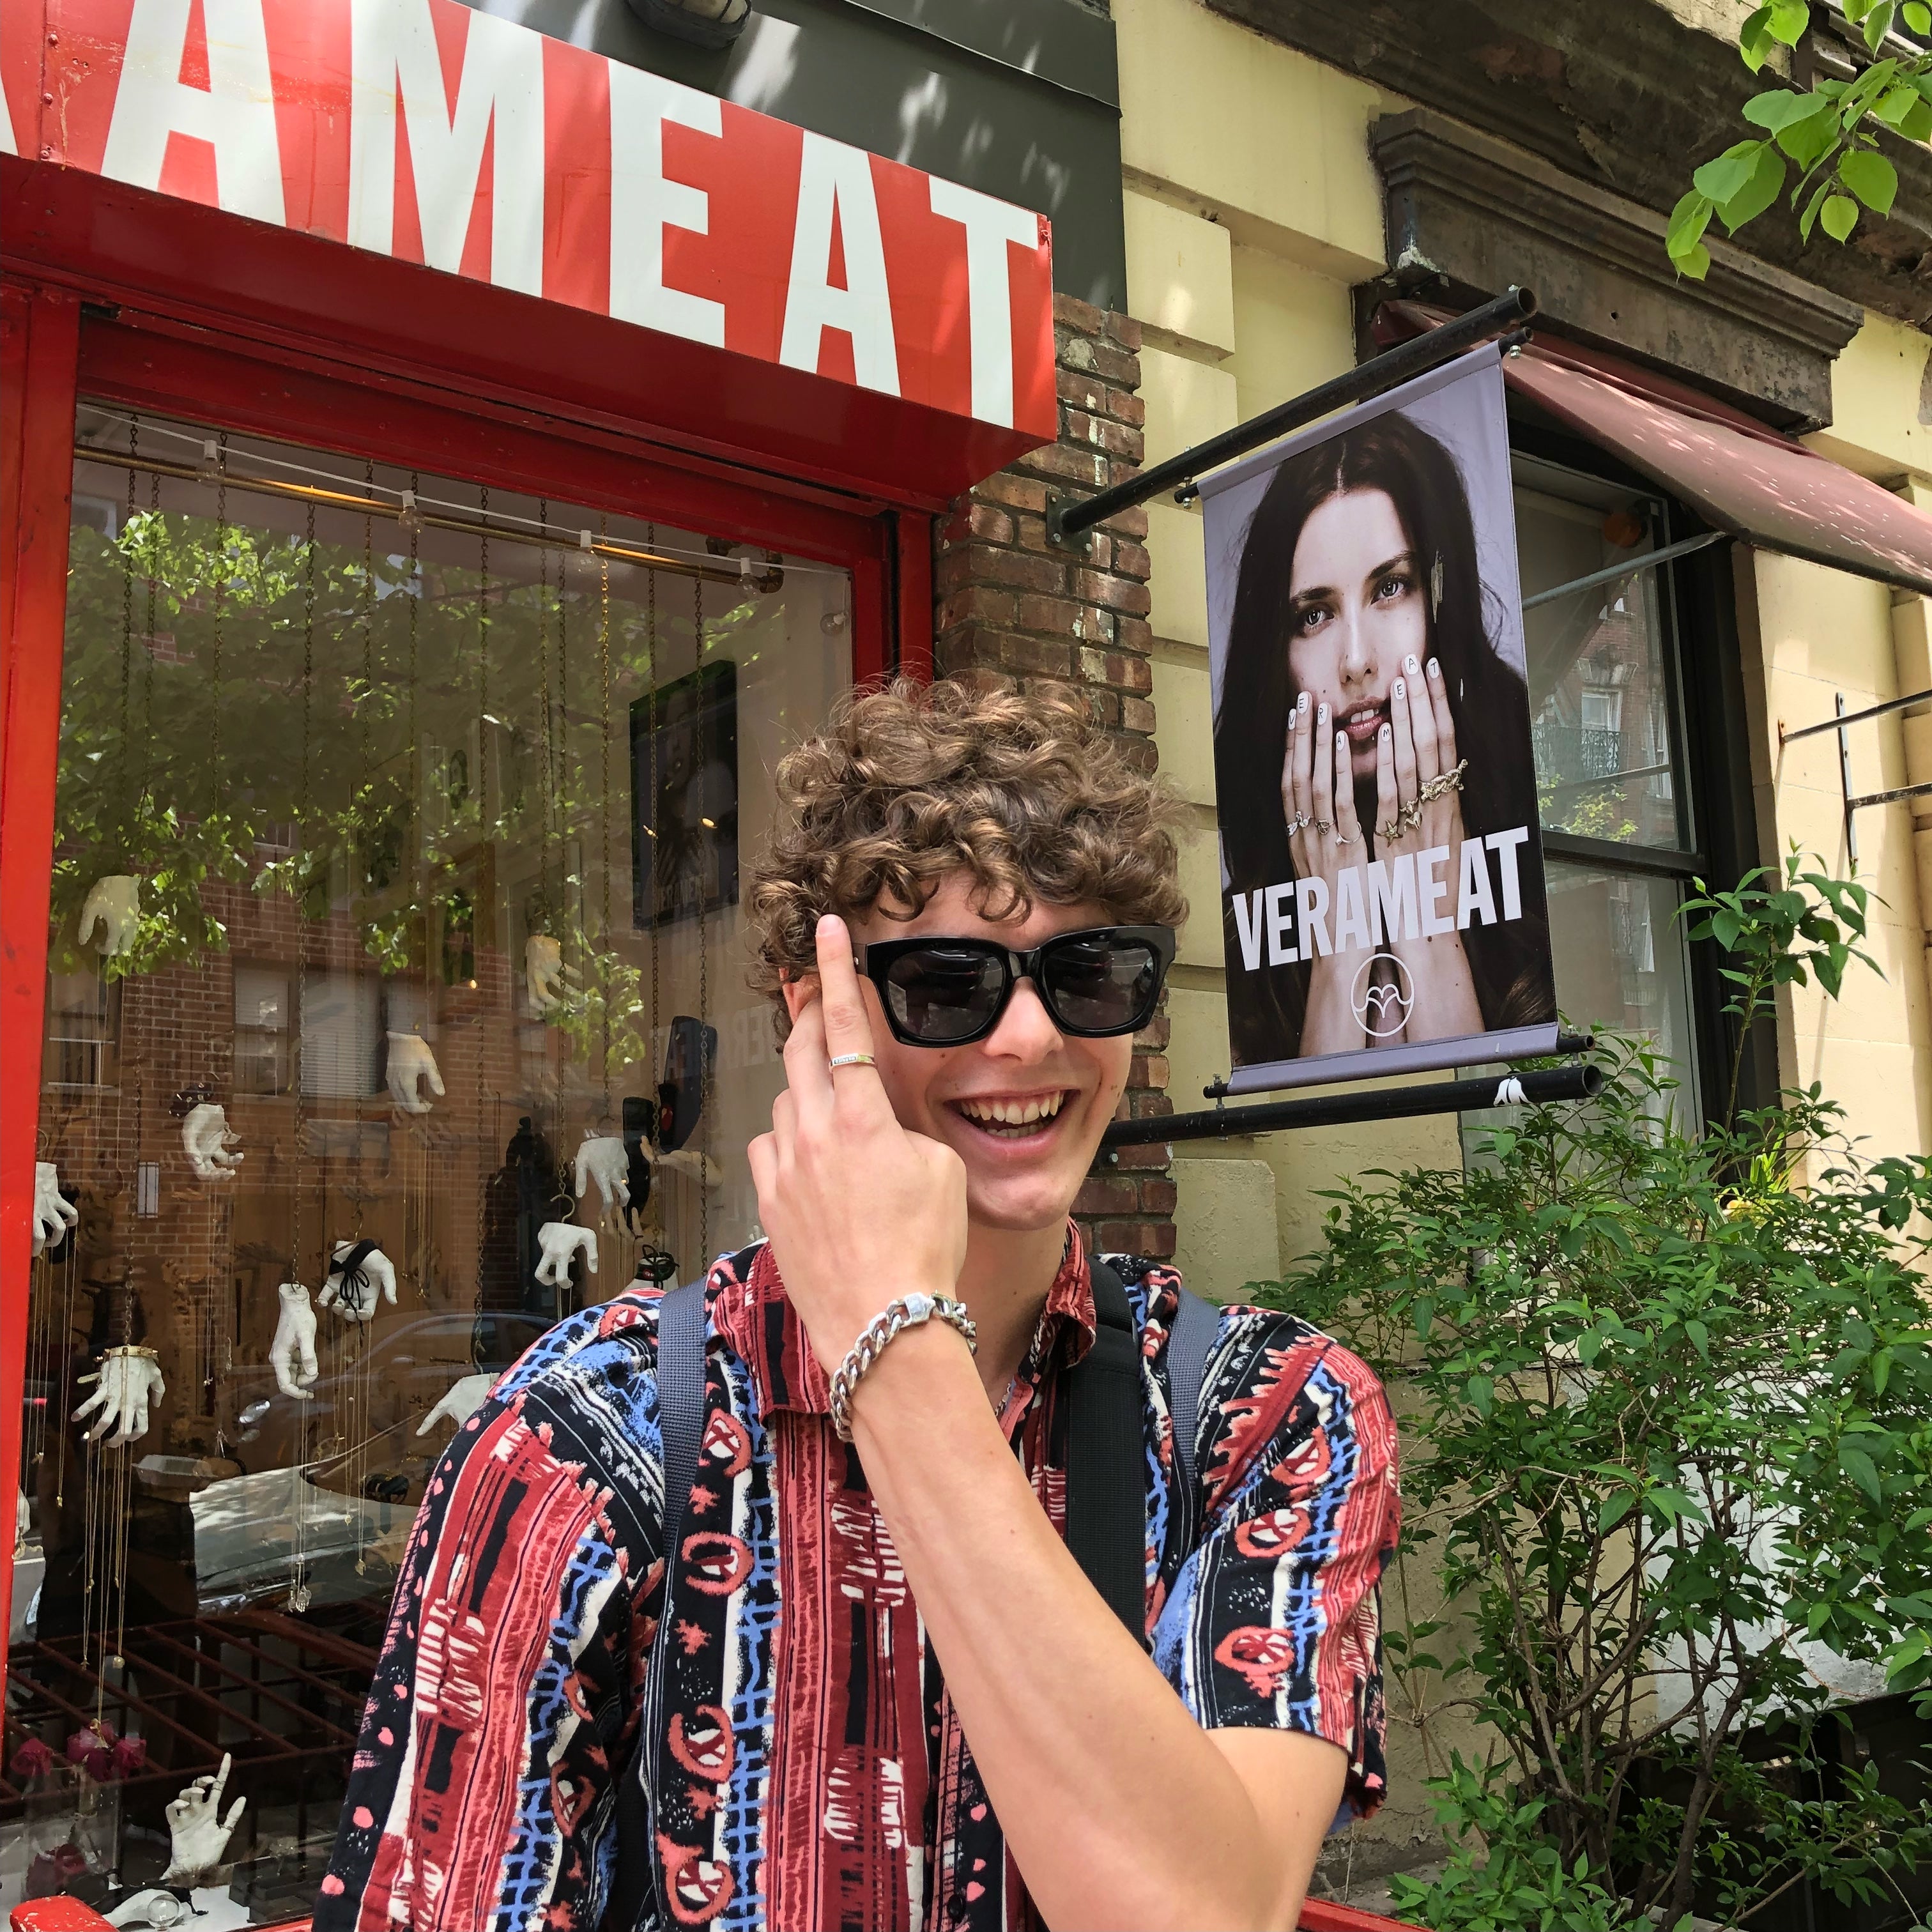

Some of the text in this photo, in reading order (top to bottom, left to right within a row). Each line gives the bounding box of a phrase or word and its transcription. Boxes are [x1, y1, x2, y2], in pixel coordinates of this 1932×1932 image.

[0, 0, 1039, 429] AMEAT
[1289, 657, 1438, 745] V E R A M E A T
[1232, 825, 1529, 972] VERAMEAT
